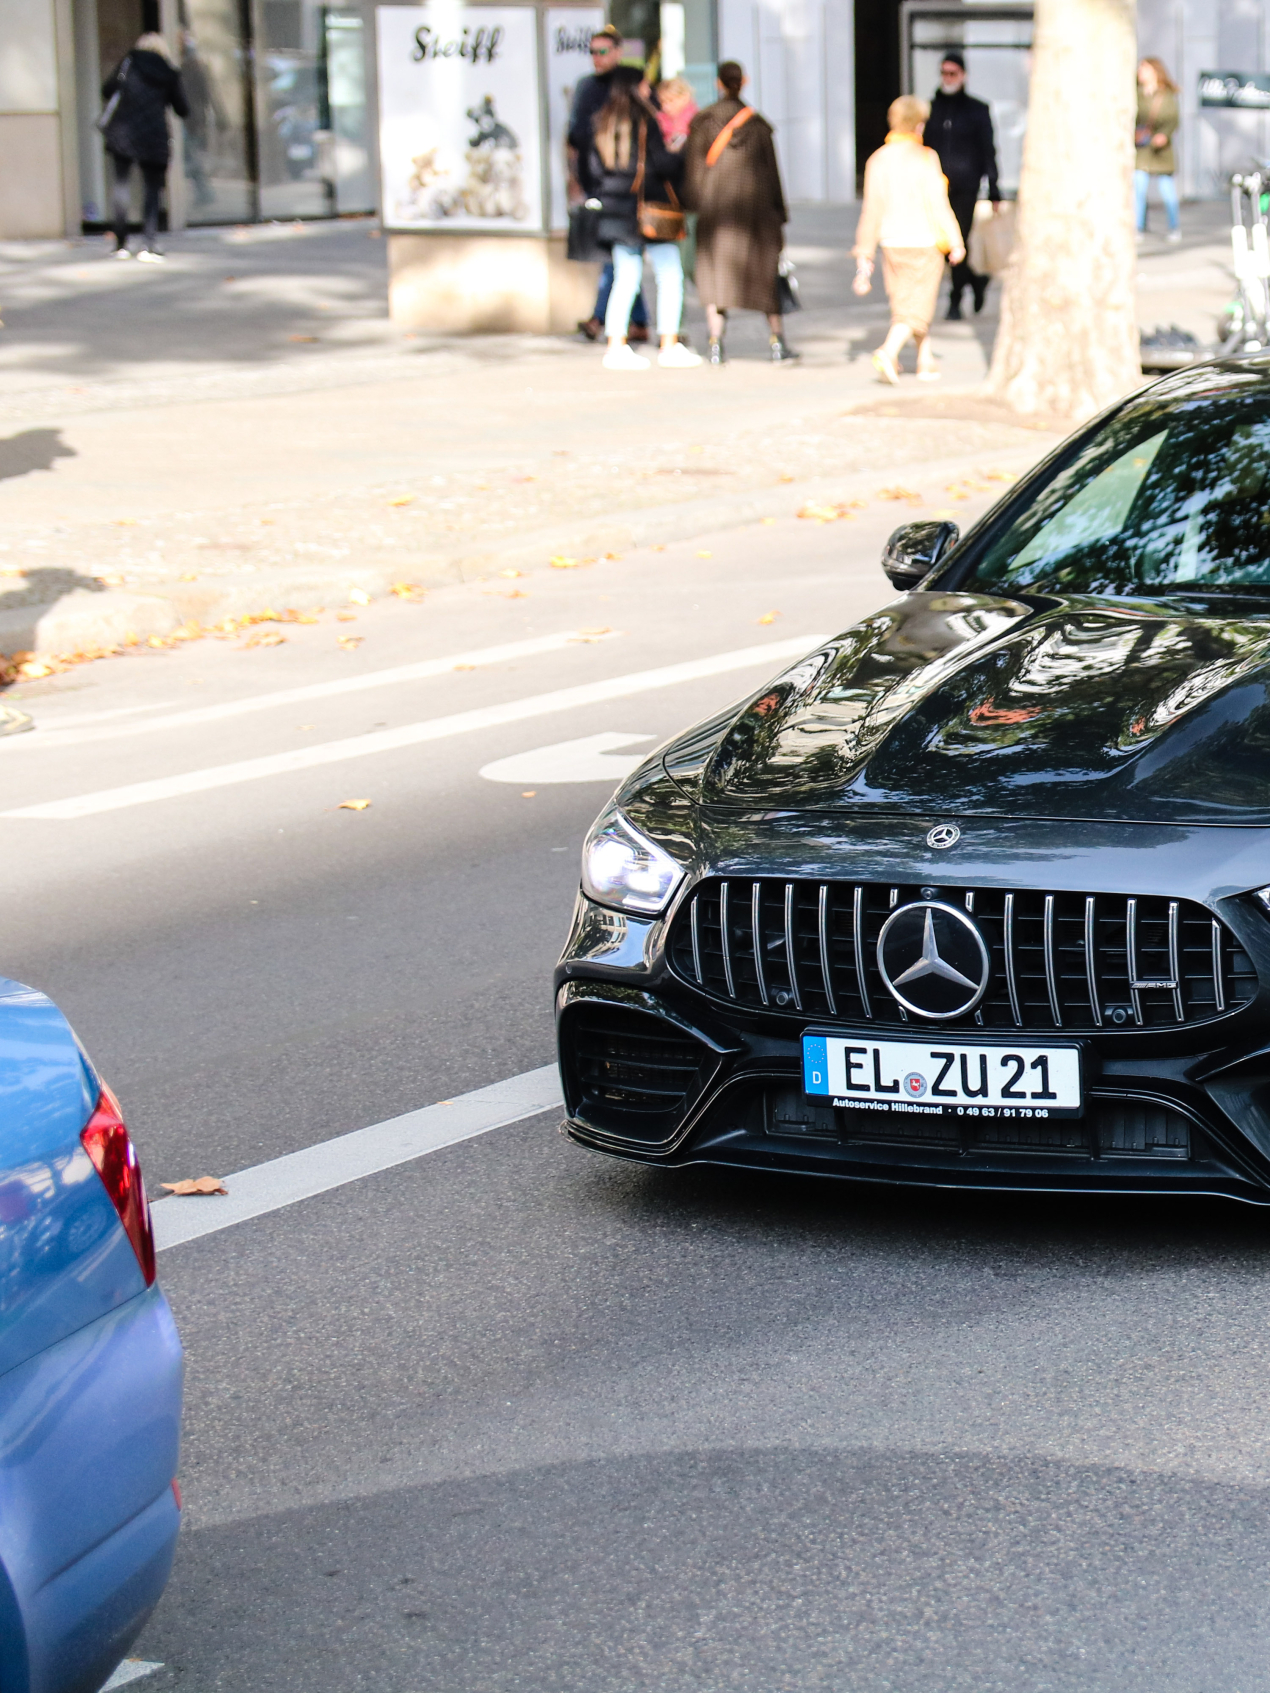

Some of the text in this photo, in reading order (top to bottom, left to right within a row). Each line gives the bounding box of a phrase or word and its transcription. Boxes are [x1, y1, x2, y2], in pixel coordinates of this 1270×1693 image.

[411, 23, 504, 63] Steiff
[812, 1071, 822, 1084] D
[844, 1046, 900, 1093] EL
[930, 1051, 989, 1098] ZU
[1000, 1053, 1057, 1100] 21
[832, 1098, 889, 1111] Autoservice
[891, 1102, 943, 1115] Hillebrand
[957, 1107, 964, 1115] 0
[966, 1108, 980, 1116] 49
[981, 1108, 995, 1116] 63
[1003, 1109, 1016, 1117] 91
[1019, 1109, 1033, 1118] 79
[1035, 1109, 1049, 1118] 06
